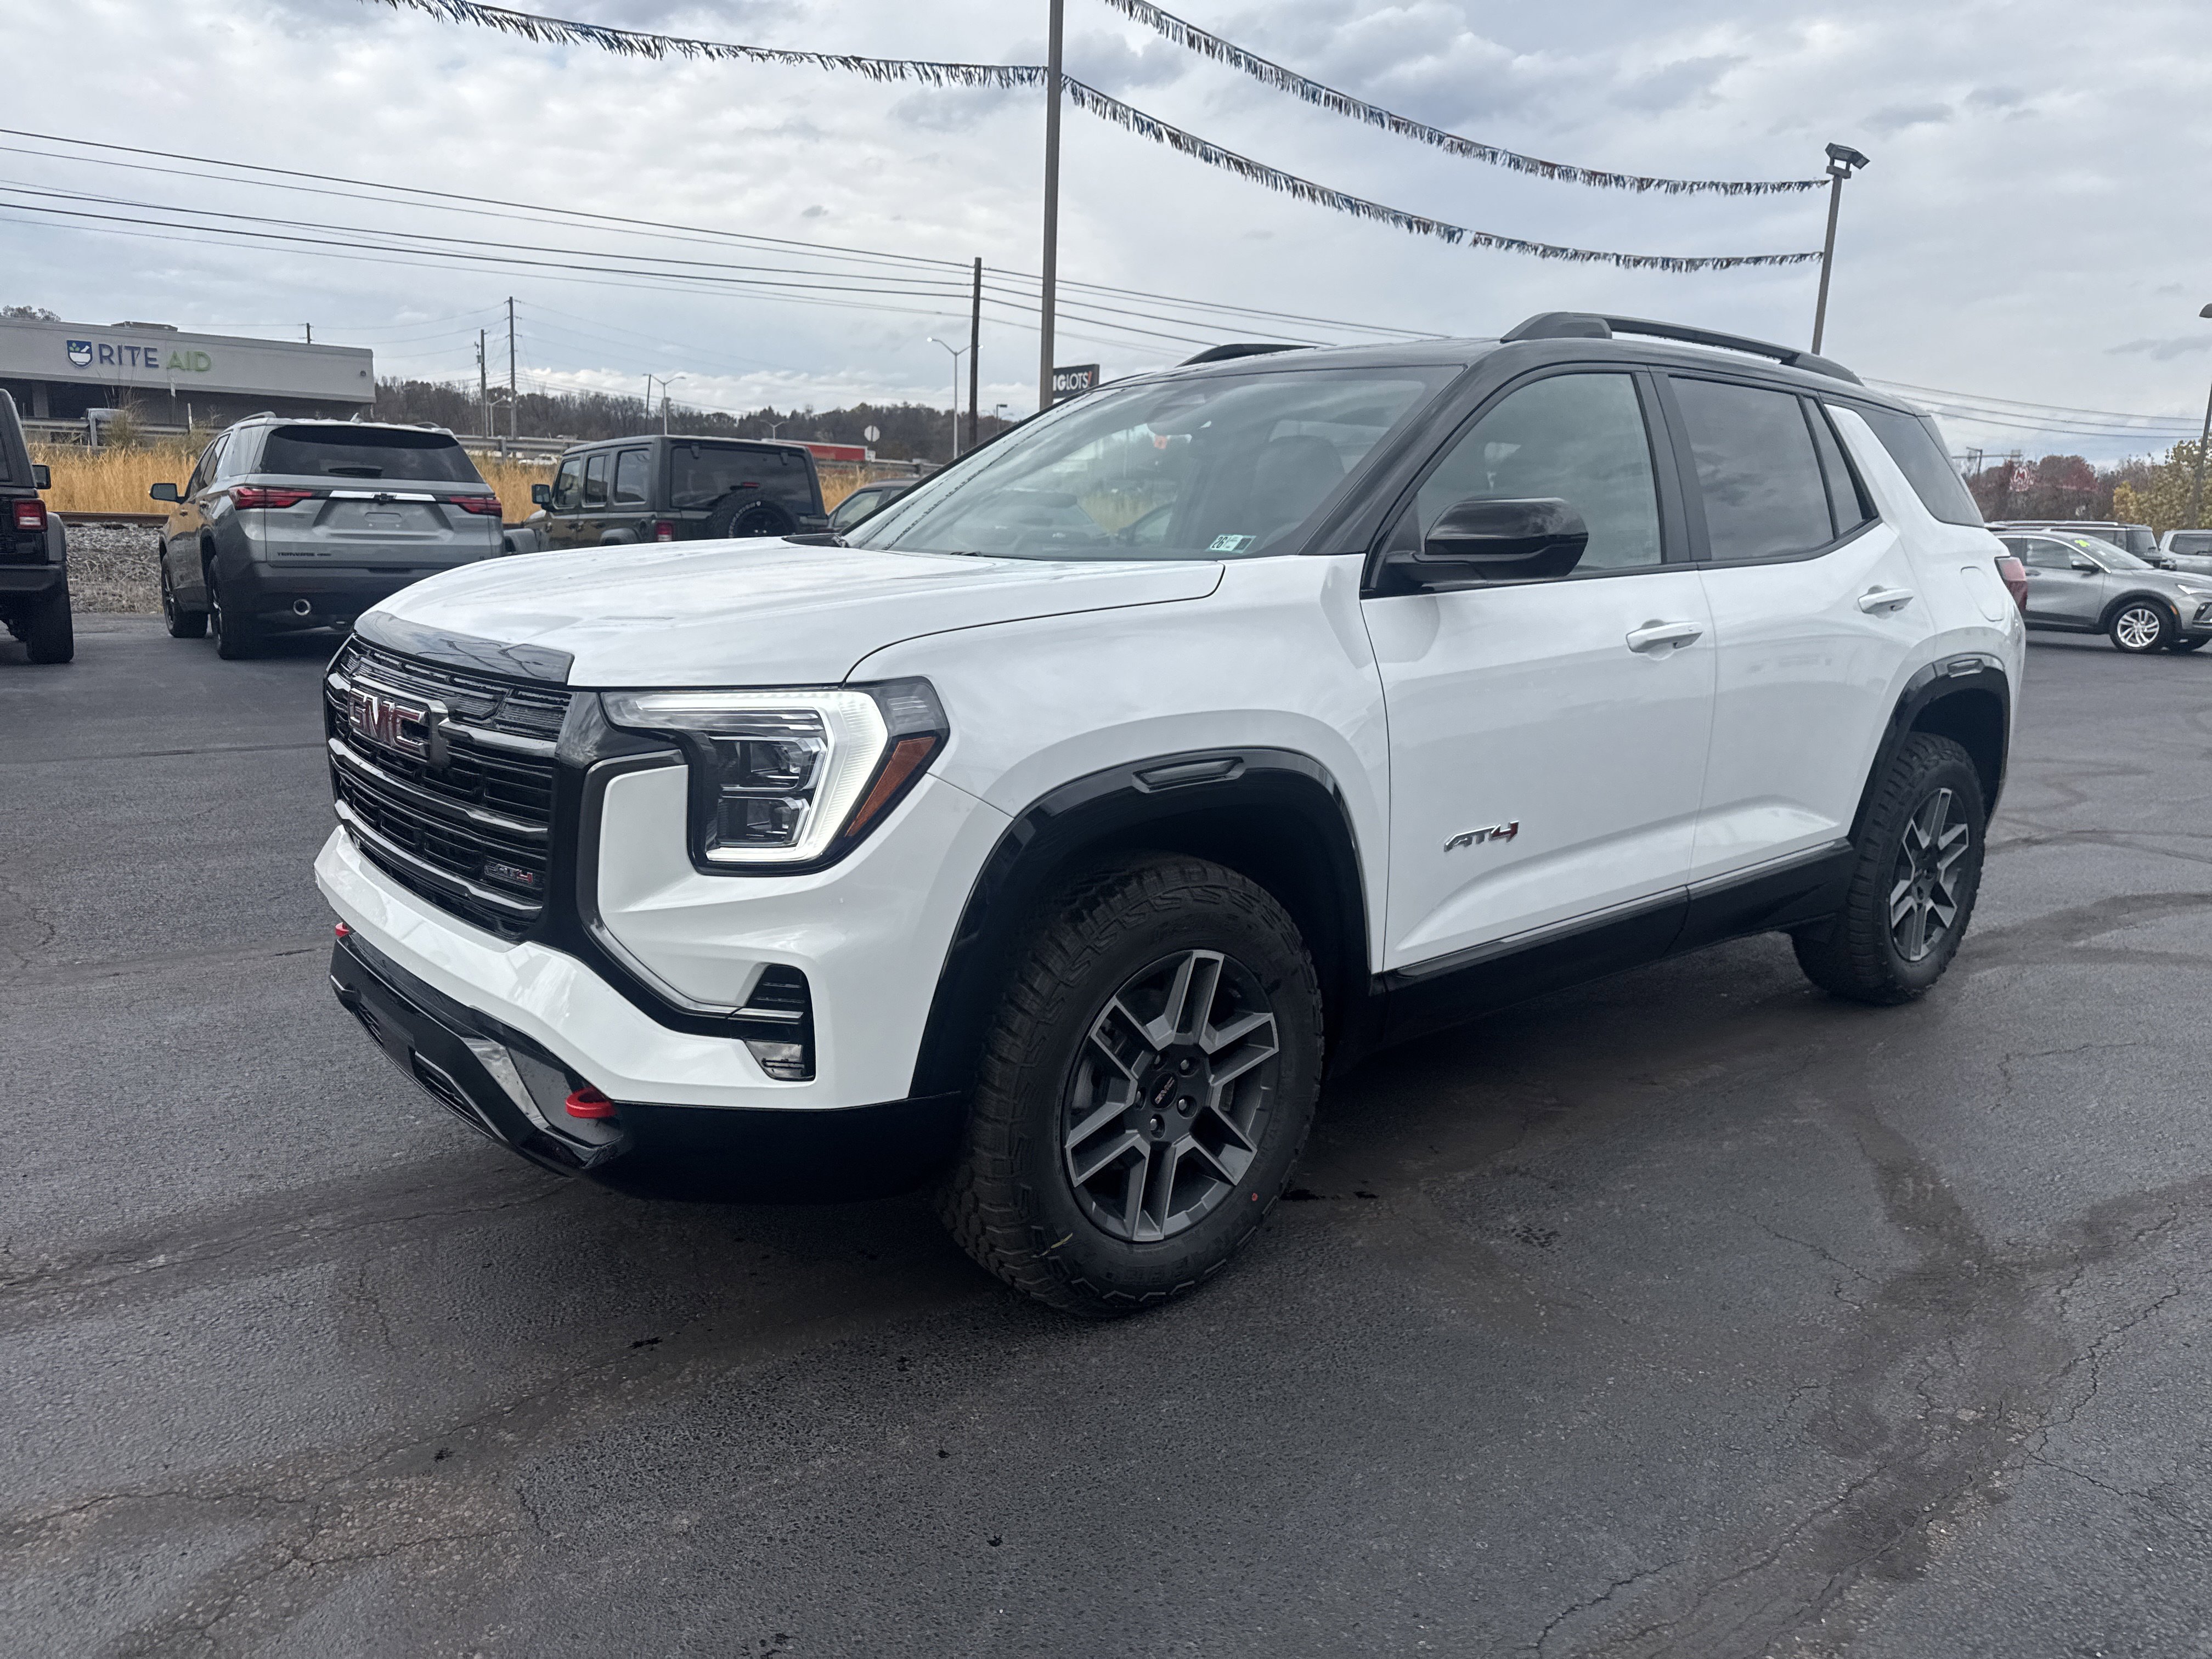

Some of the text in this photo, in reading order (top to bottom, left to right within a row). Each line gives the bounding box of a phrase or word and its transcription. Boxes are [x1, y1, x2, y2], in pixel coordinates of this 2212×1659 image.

[98, 343, 212, 372] RITE AID
[348, 687, 427, 759] GMC
[1443, 820, 1519, 853] AT4
[1154, 1076, 1175, 1104] GMC
